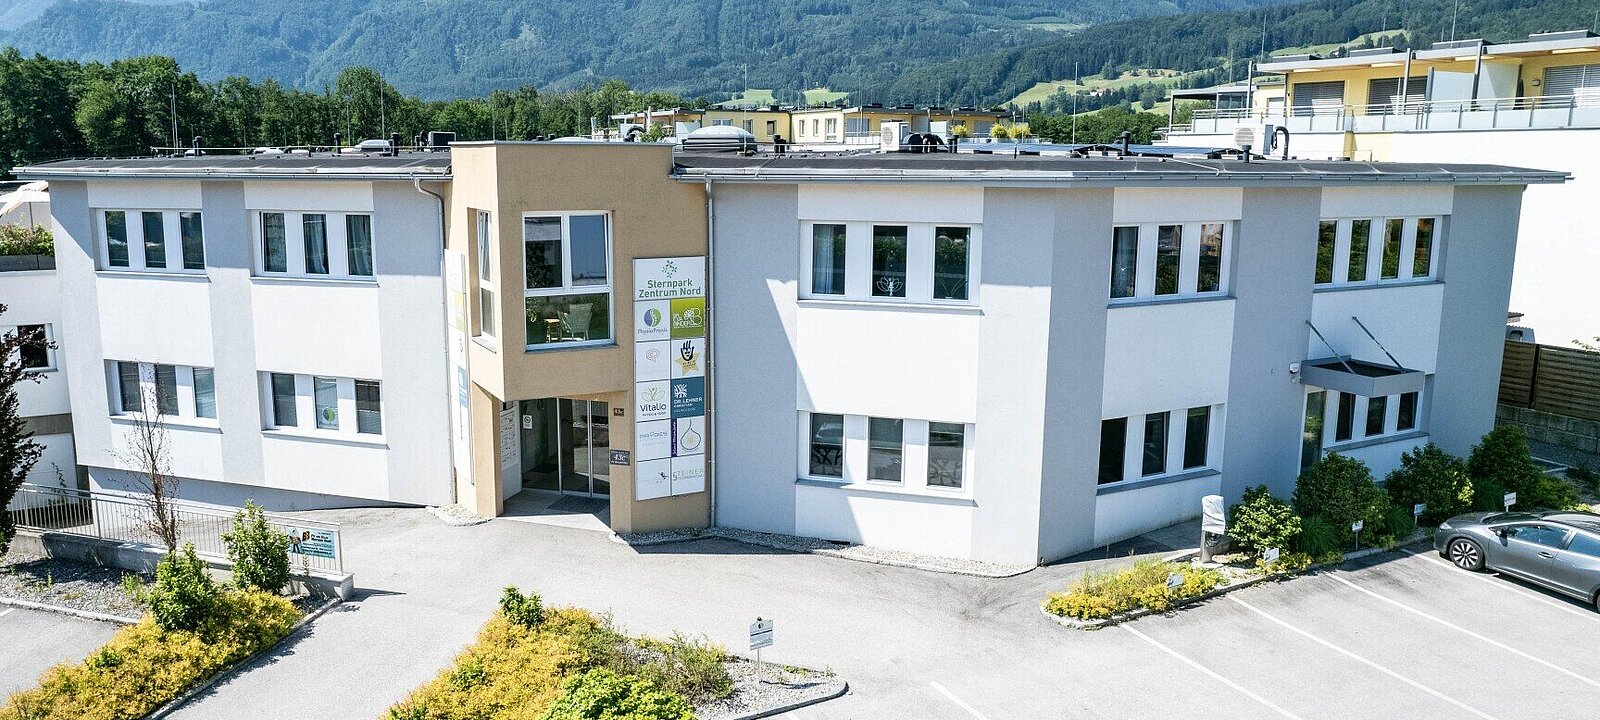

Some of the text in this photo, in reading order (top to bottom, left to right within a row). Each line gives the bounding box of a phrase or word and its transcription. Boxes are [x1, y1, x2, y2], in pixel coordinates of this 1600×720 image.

[648, 279, 692, 289] Sternpark
[639, 287, 701, 298] Zentrum Nord
